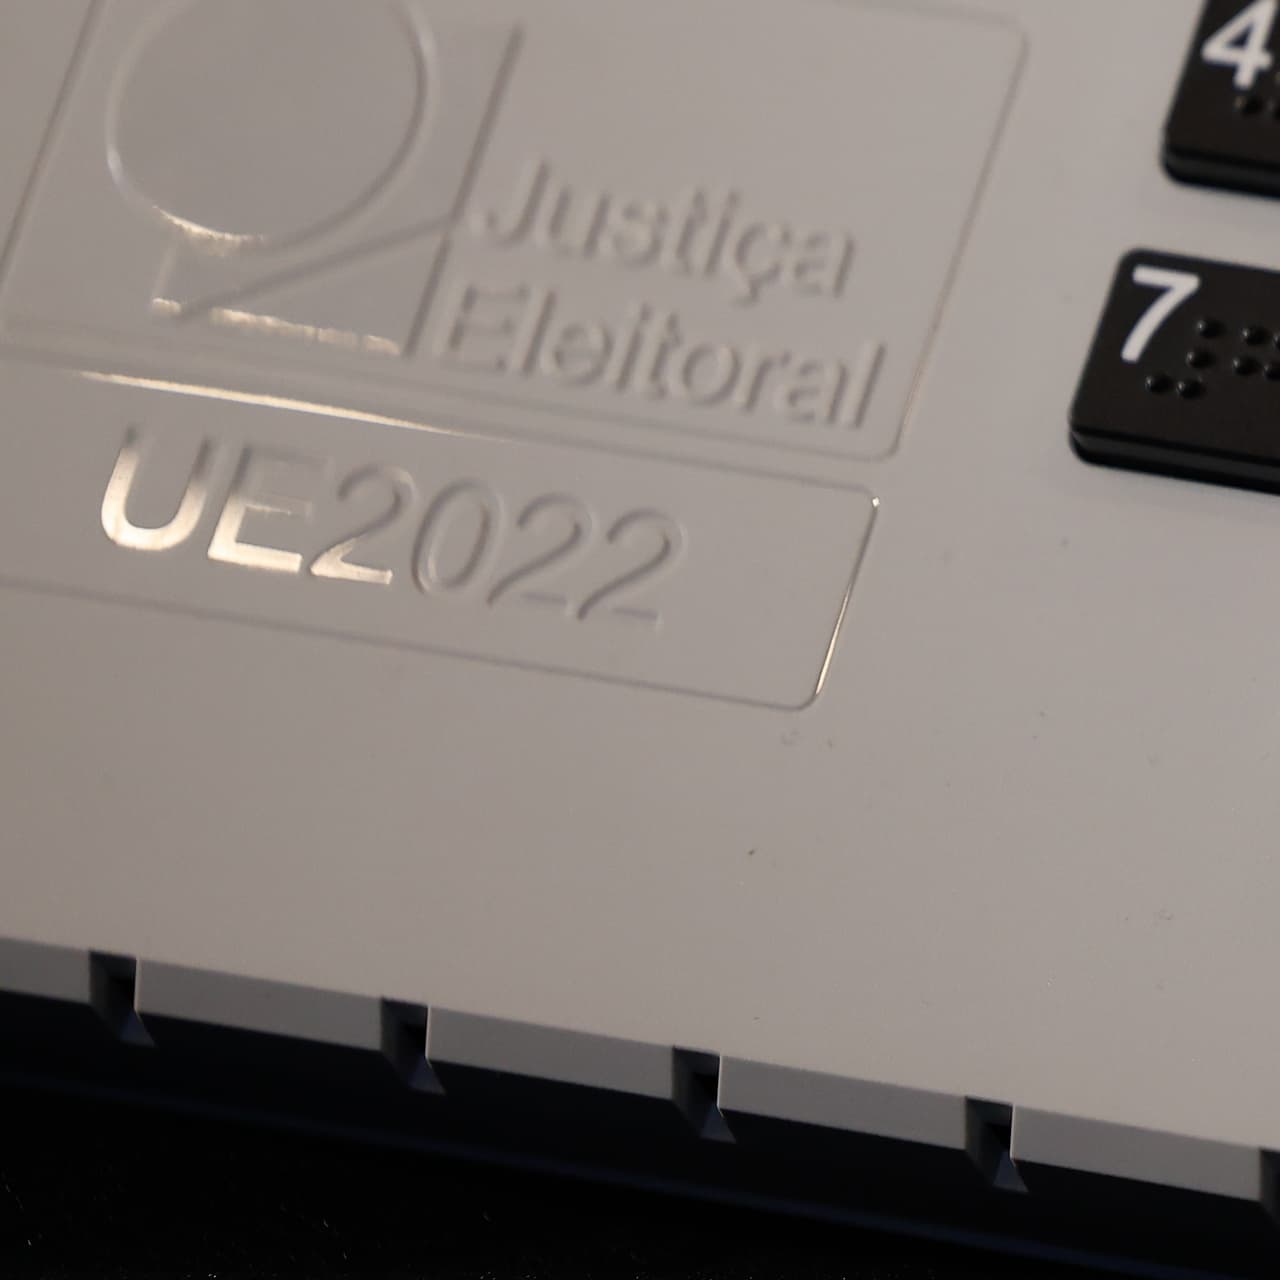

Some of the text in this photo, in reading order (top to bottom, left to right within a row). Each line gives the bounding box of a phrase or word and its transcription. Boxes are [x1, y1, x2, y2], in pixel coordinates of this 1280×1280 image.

[472, 157, 858, 305] Justiça
[443, 280, 888, 432] Eleitoral
[1119, 265, 1200, 364] 7
[99, 426, 685, 628] UE2022
